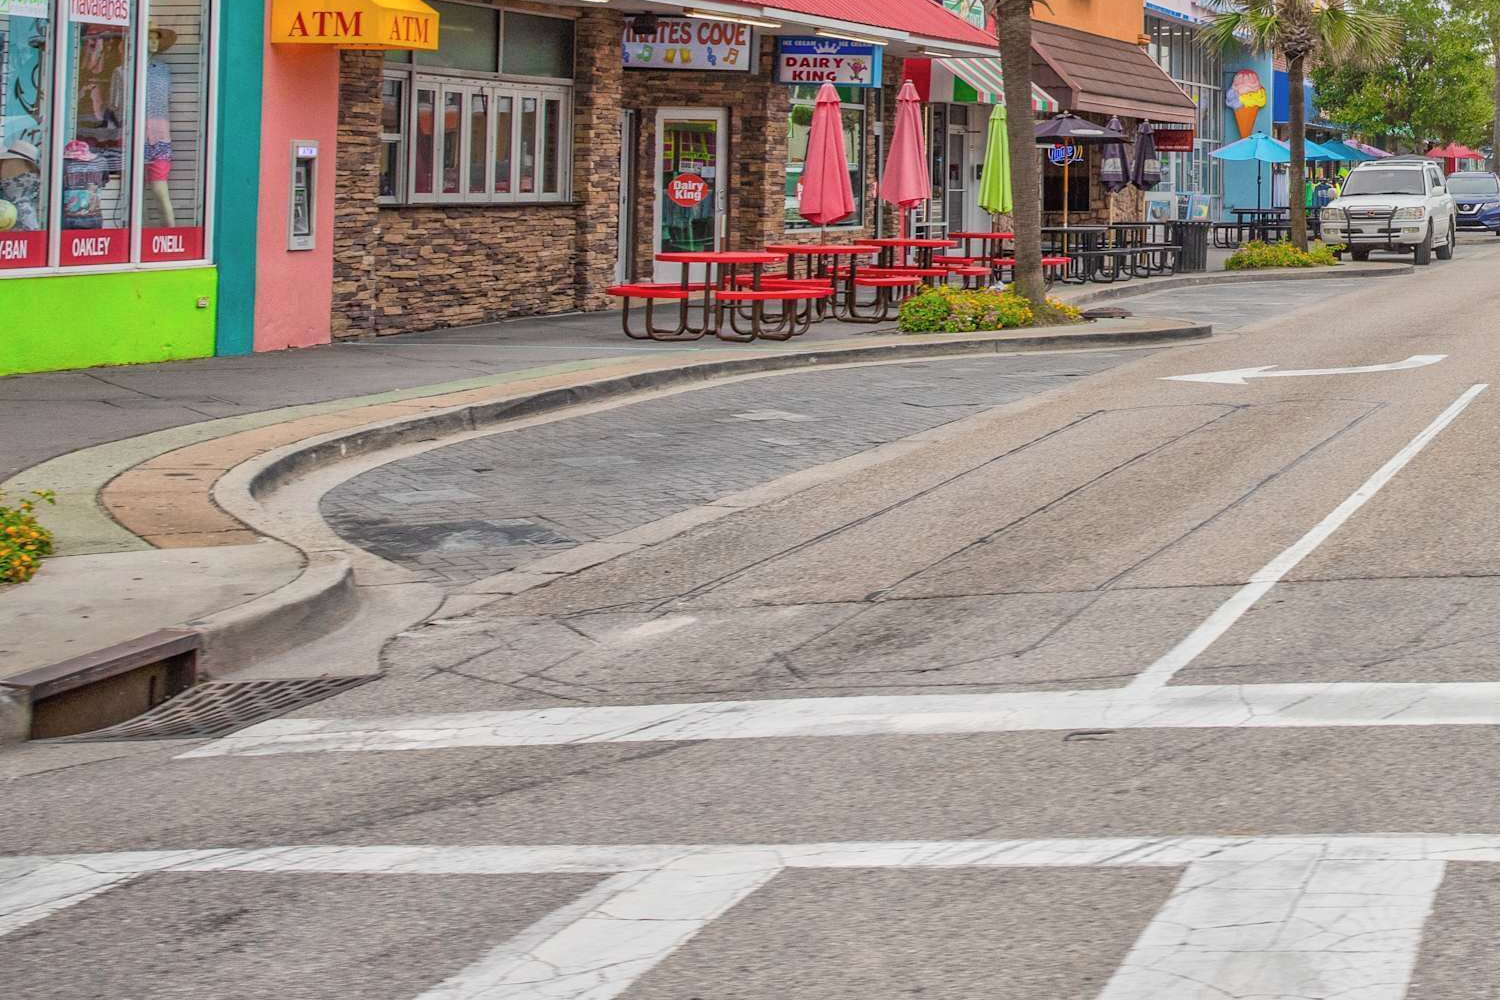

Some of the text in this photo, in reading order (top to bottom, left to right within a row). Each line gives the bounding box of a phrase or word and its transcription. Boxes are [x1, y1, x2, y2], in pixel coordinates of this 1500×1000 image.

[288, 11, 363, 36] ATM
[389, 15, 430, 43] ATM
[697, 22, 746, 45] COVE
[785, 56, 844, 69] DAIRY
[792, 70, 837, 82] KING
[673, 180, 704, 192] Dairy
[675, 190, 702, 202] King
[72, 237, 110, 257] OAKLEY
[152, 235, 185, 254] O'NEILL
